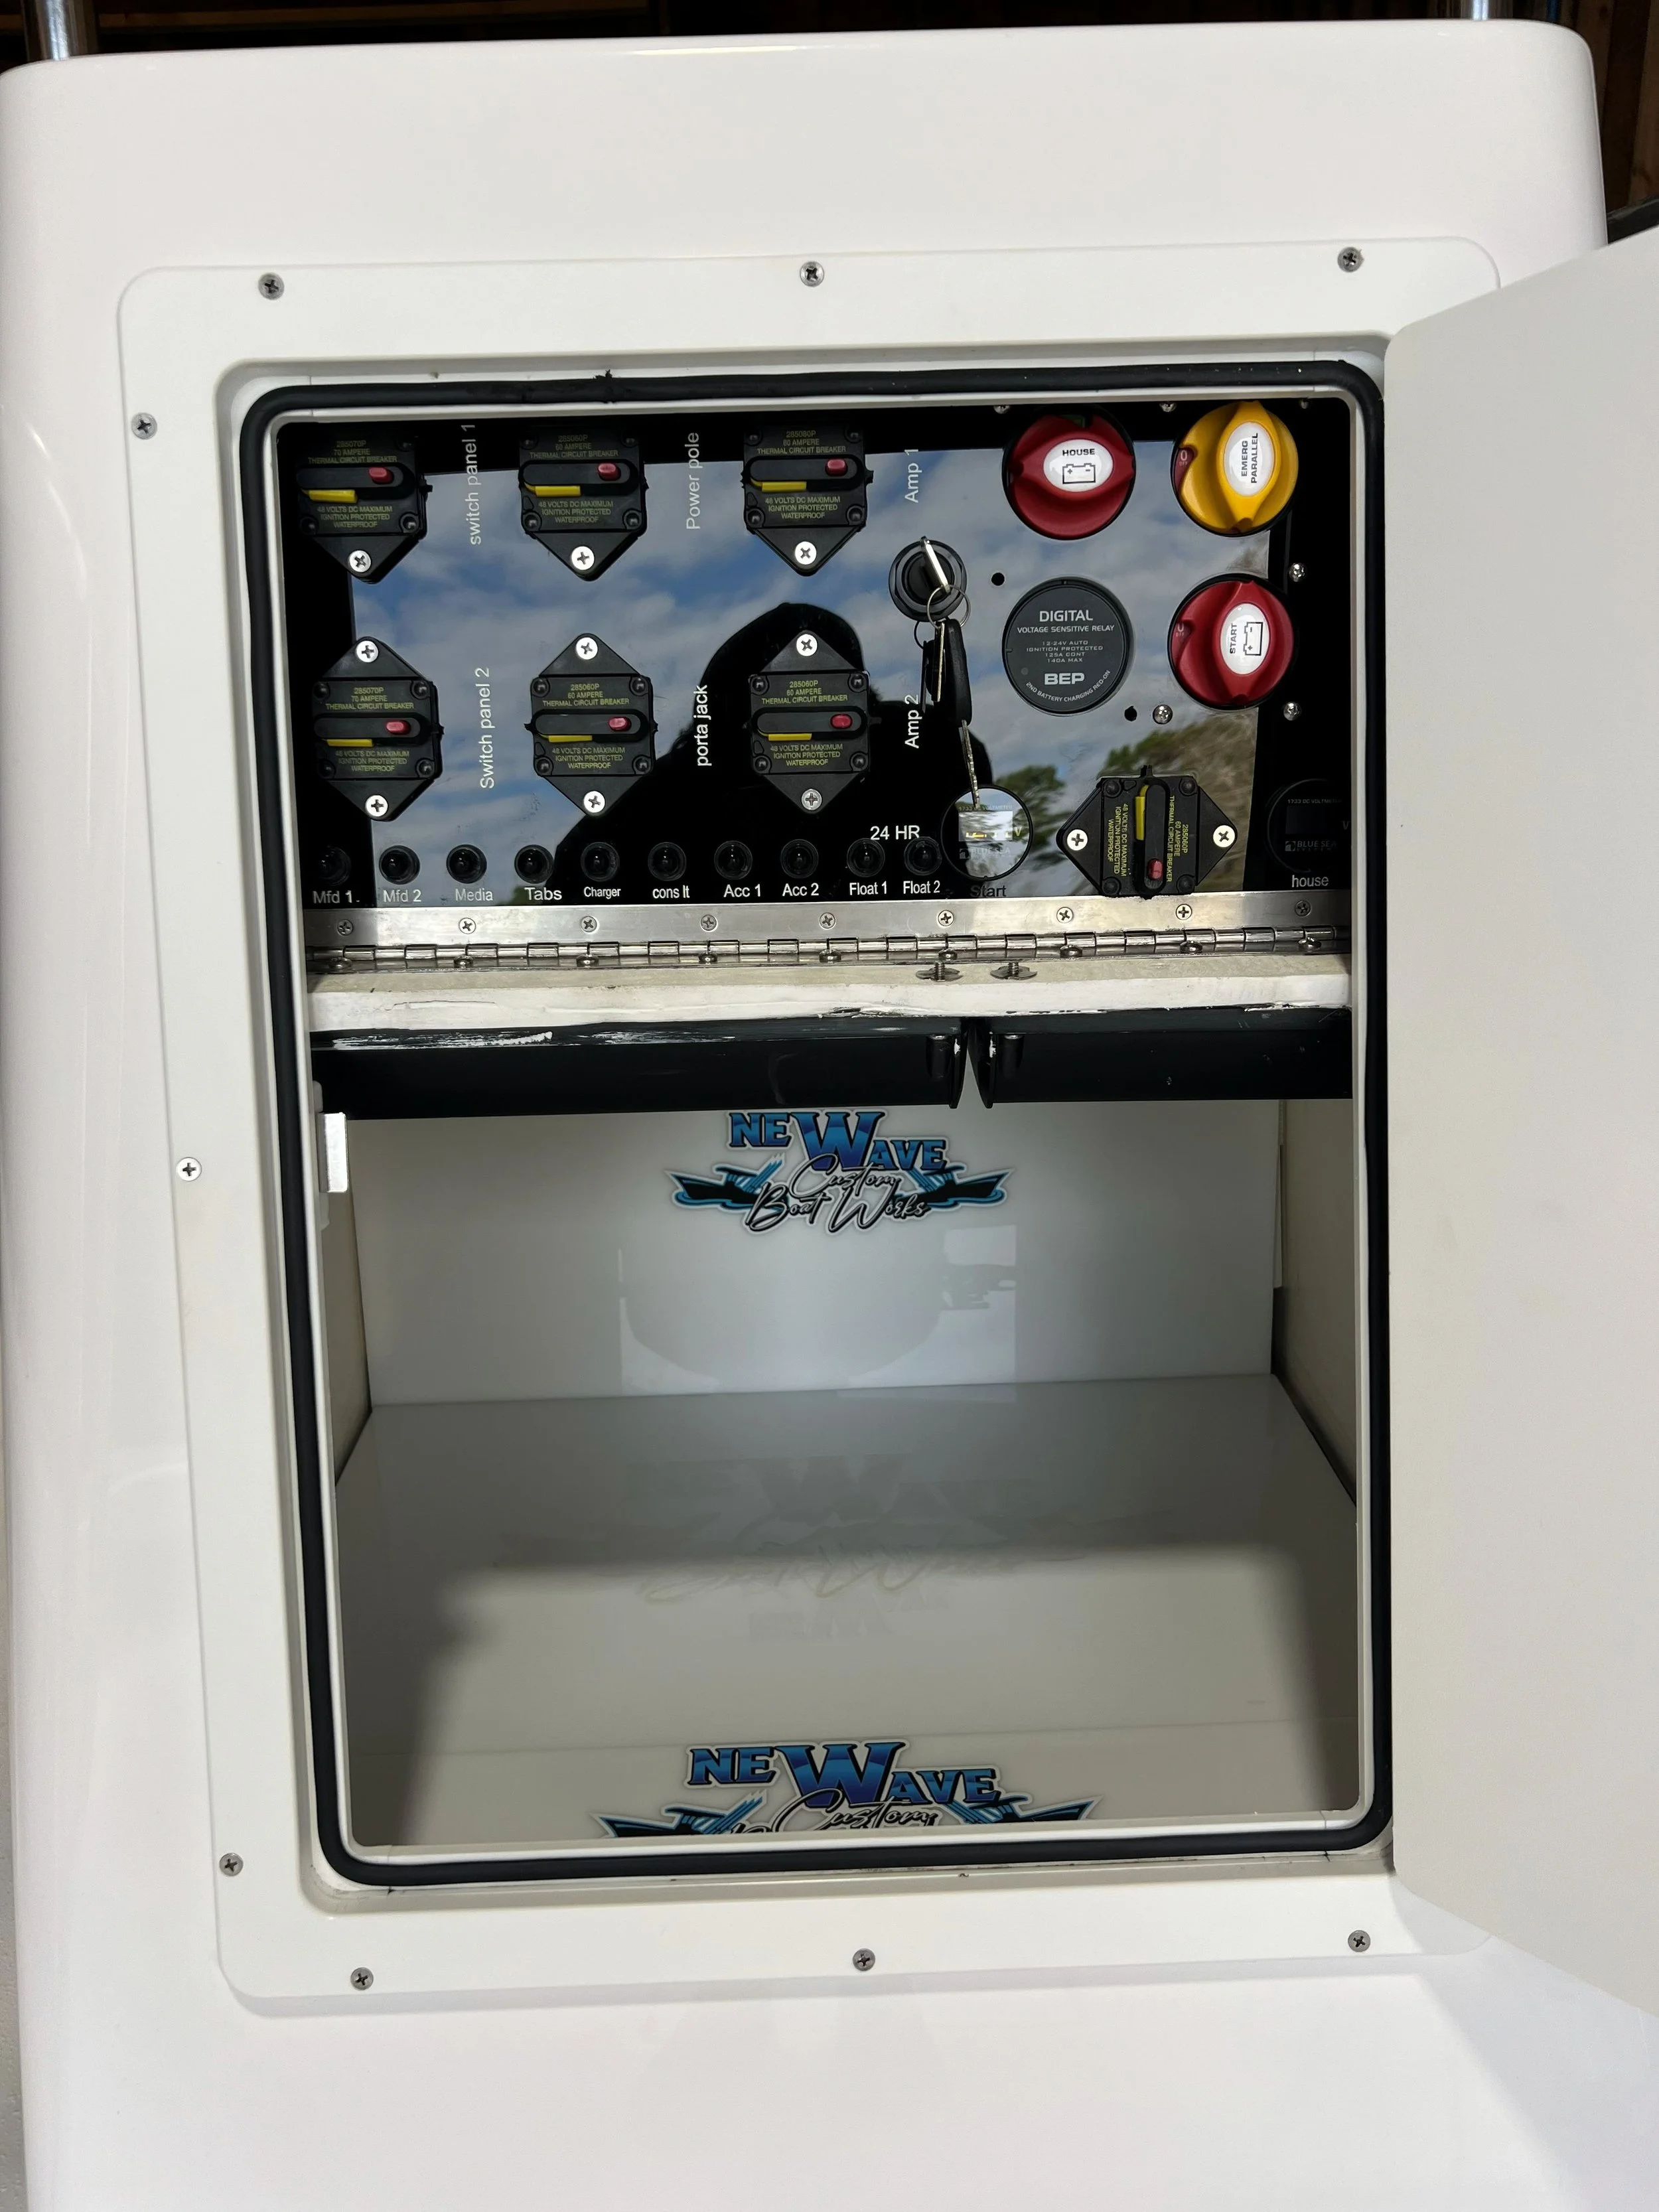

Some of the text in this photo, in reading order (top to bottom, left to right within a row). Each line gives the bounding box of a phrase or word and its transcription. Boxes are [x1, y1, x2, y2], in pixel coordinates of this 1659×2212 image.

[462, 439, 481, 485] panel
[684, 433, 703, 529] Power pole
[904, 463, 922, 503] Amp
[465, 492, 481, 545] switch
[1039, 609, 1093, 622] DIGITAL
[1026, 670, 1110, 701] 2ND BATTERY CHARGING RED-ON
[1045, 672, 1085, 685] BEP
[475, 667, 496, 788] Switch panel 2
[693, 684, 712, 767] porta jack
[904, 694, 923, 749] Amp 2
[870, 825, 920, 840] 24 HR
[1121, 834, 1127, 844] DC
[902, 881, 941, 895] Float 2
[1291, 875, 1329, 888] house
[384, 889, 423, 902] Mfd 2
[456, 888, 494, 901] Media
[524, 887, 563, 901] Tabs
[584, 887, 621, 900] Charger
[652, 887, 680, 899] cons
[723, 884, 761, 897] Acc 1
[782, 883, 820, 897] Acc 2
[849, 882, 888, 896] Float 1
[312, 890, 340, 903] Mfd
[790, 1154, 900, 1199] Custom
[746, 1182, 931, 1233] Boat Works
